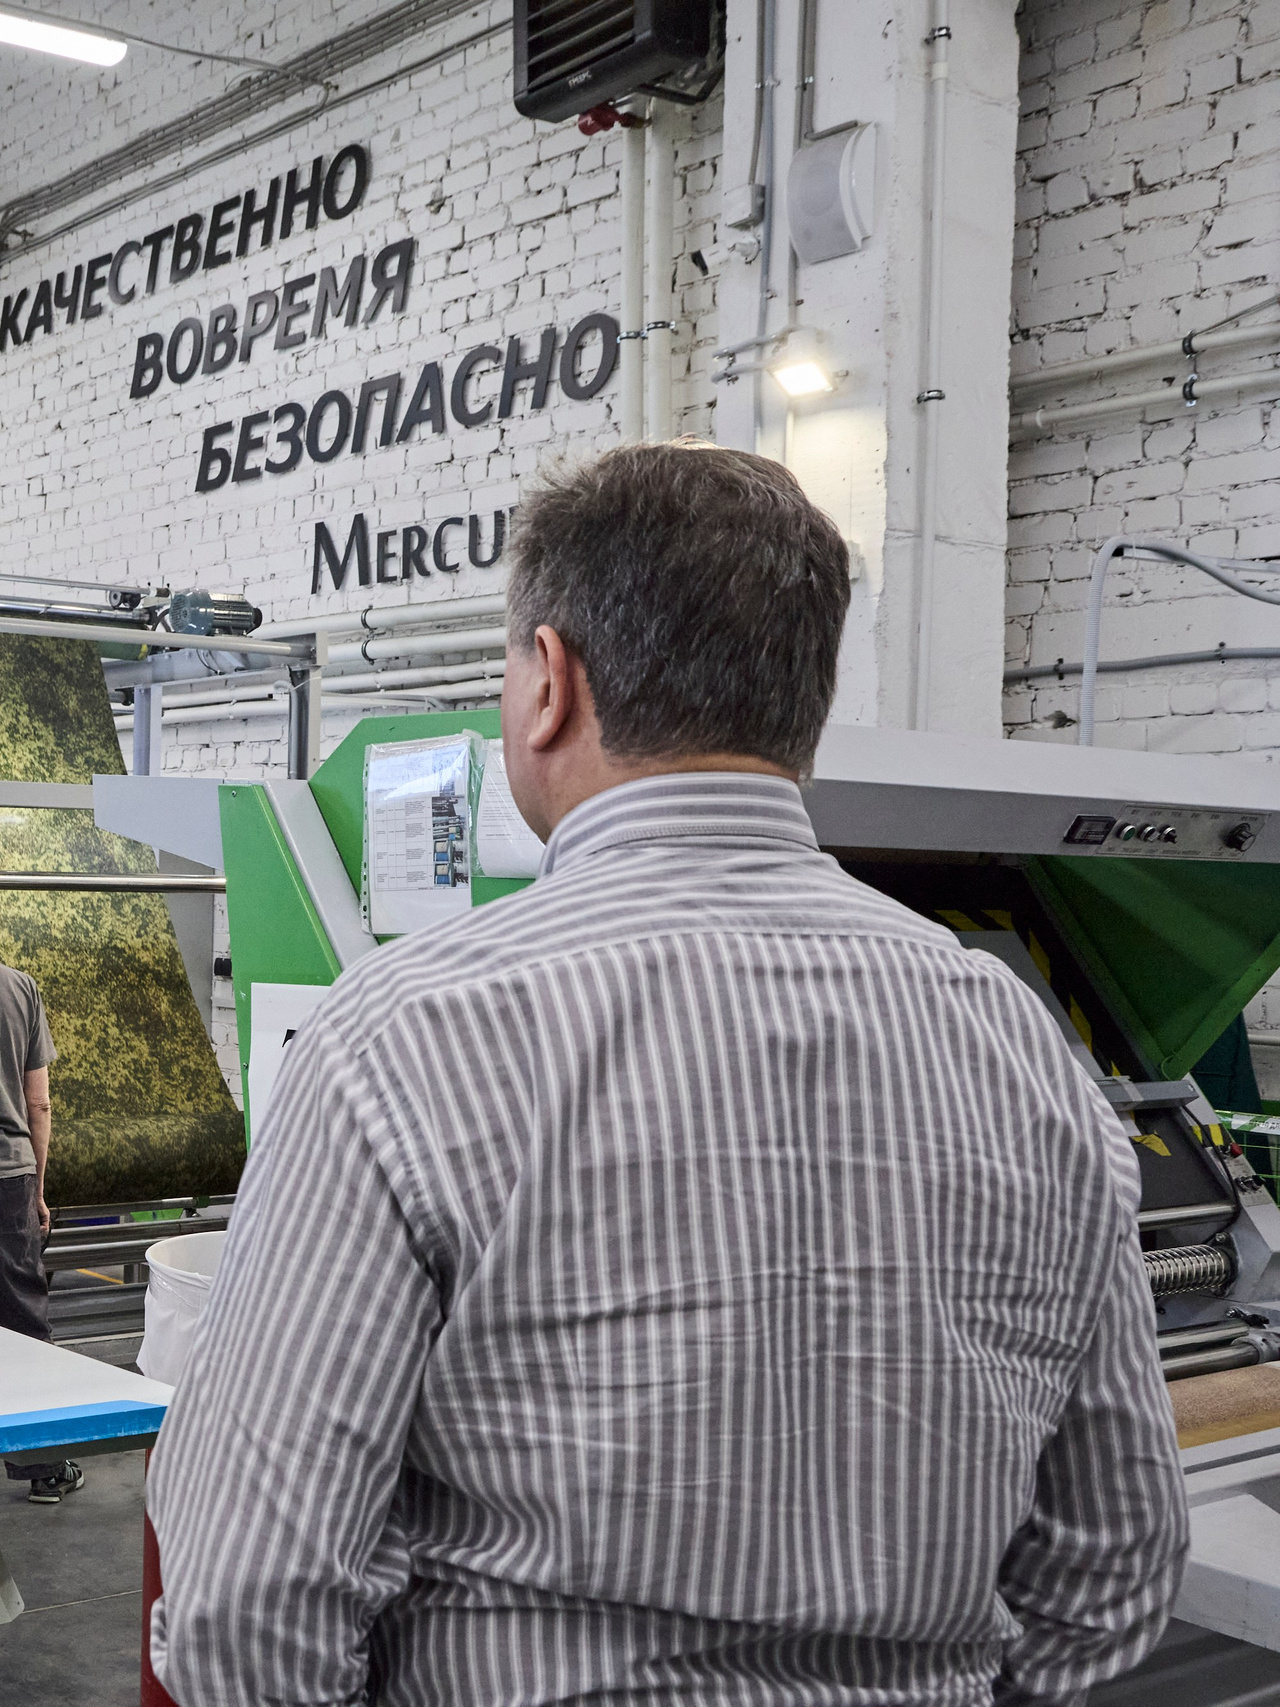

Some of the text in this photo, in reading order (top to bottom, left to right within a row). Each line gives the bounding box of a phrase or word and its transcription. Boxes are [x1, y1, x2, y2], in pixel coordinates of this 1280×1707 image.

[130, 237, 416, 399] ВОВРЕМЯ
[195, 313, 620, 493] БЕЗОПАСНО
[311, 504, 519, 595] MERCU
